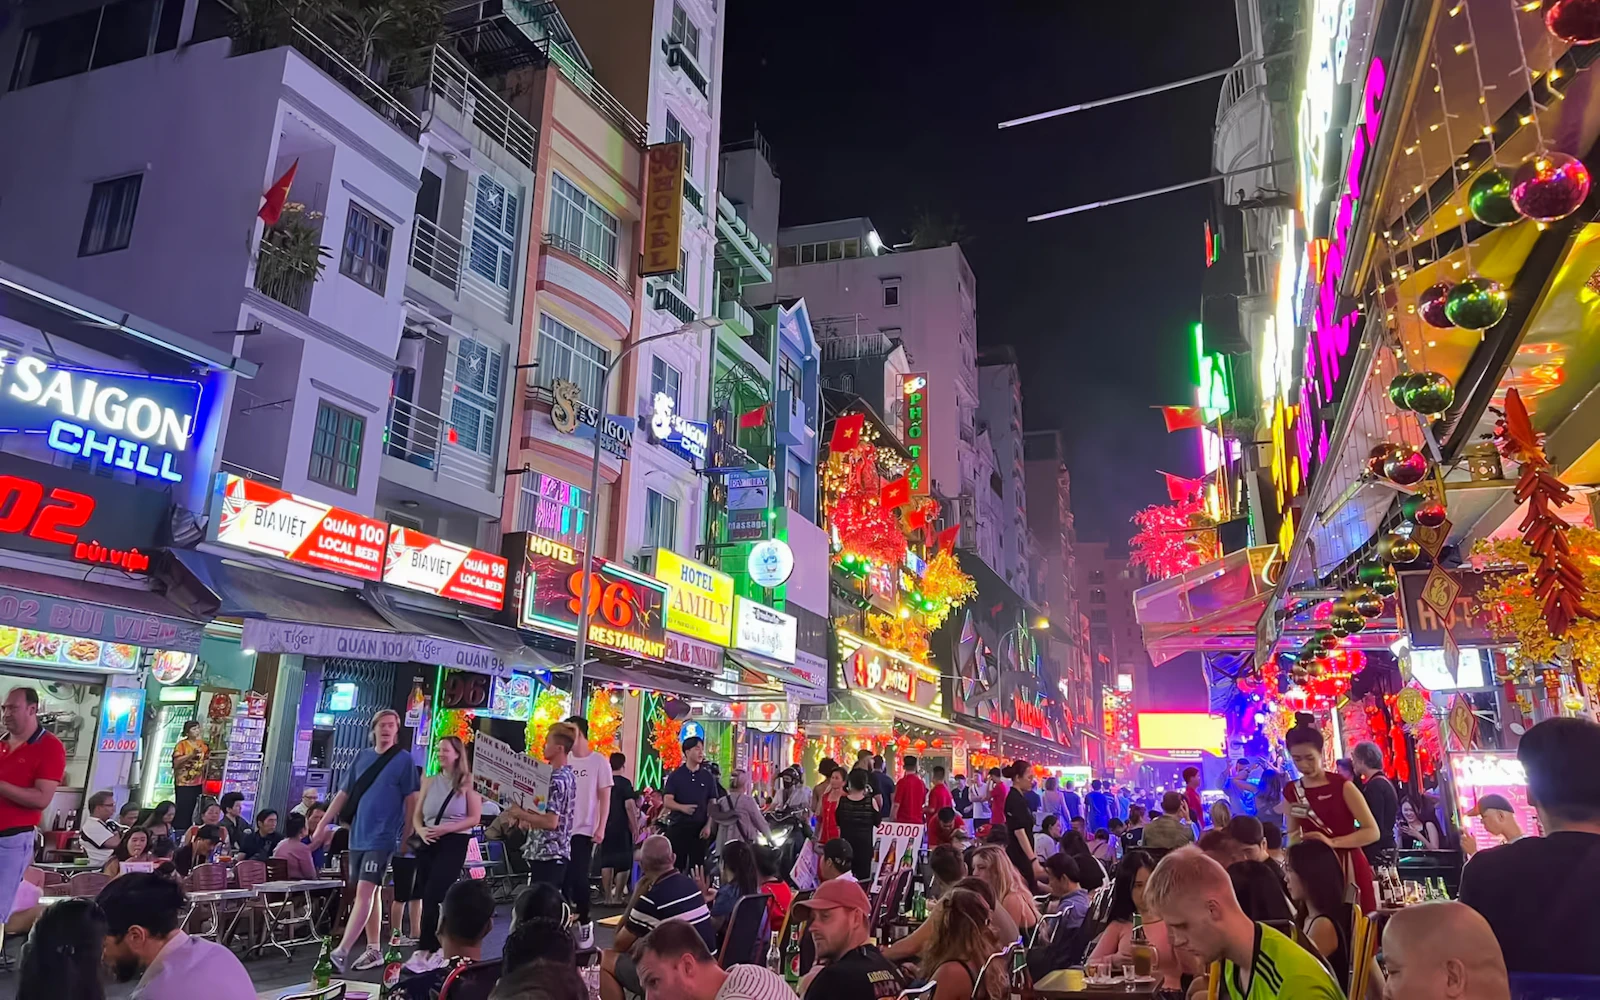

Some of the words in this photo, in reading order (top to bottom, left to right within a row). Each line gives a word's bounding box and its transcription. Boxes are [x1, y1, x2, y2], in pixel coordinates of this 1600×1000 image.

[10, 356, 192, 451] SAIGON
[48, 420, 182, 482] CHILL
[323, 515, 356, 538] QUÁN
[360, 524, 385, 545] 100
[318, 535, 353, 556] LOCAL
[354, 544, 380, 563] BEER
[530, 536, 576, 565] HOTEL
[460, 573, 485, 588] LOCAL
[463, 558, 489, 575] QUÁN
[491, 562, 505, 579] 98
[681, 564, 714, 592] HOTEL
[568, 570, 633, 627] 96
[671, 588, 729, 625] AMILY
[50, 604, 105, 635] BÙI
[284, 630, 315, 648] Tiger
[337, 634, 376, 657] QUÁN
[382, 640, 402, 656] 100
[416, 639, 442, 658] Tiger
[456, 648, 489, 670] QUÁN
[491, 656, 505, 672] 98
[588, 625, 666, 659] RESTAURANT
[666, 637, 679, 660] PA
[445, 675, 486, 707] 96
[102, 739, 137, 751] 20.000
[514, 772, 536, 787] SHISHA
[877, 824, 919, 837] 20.000
